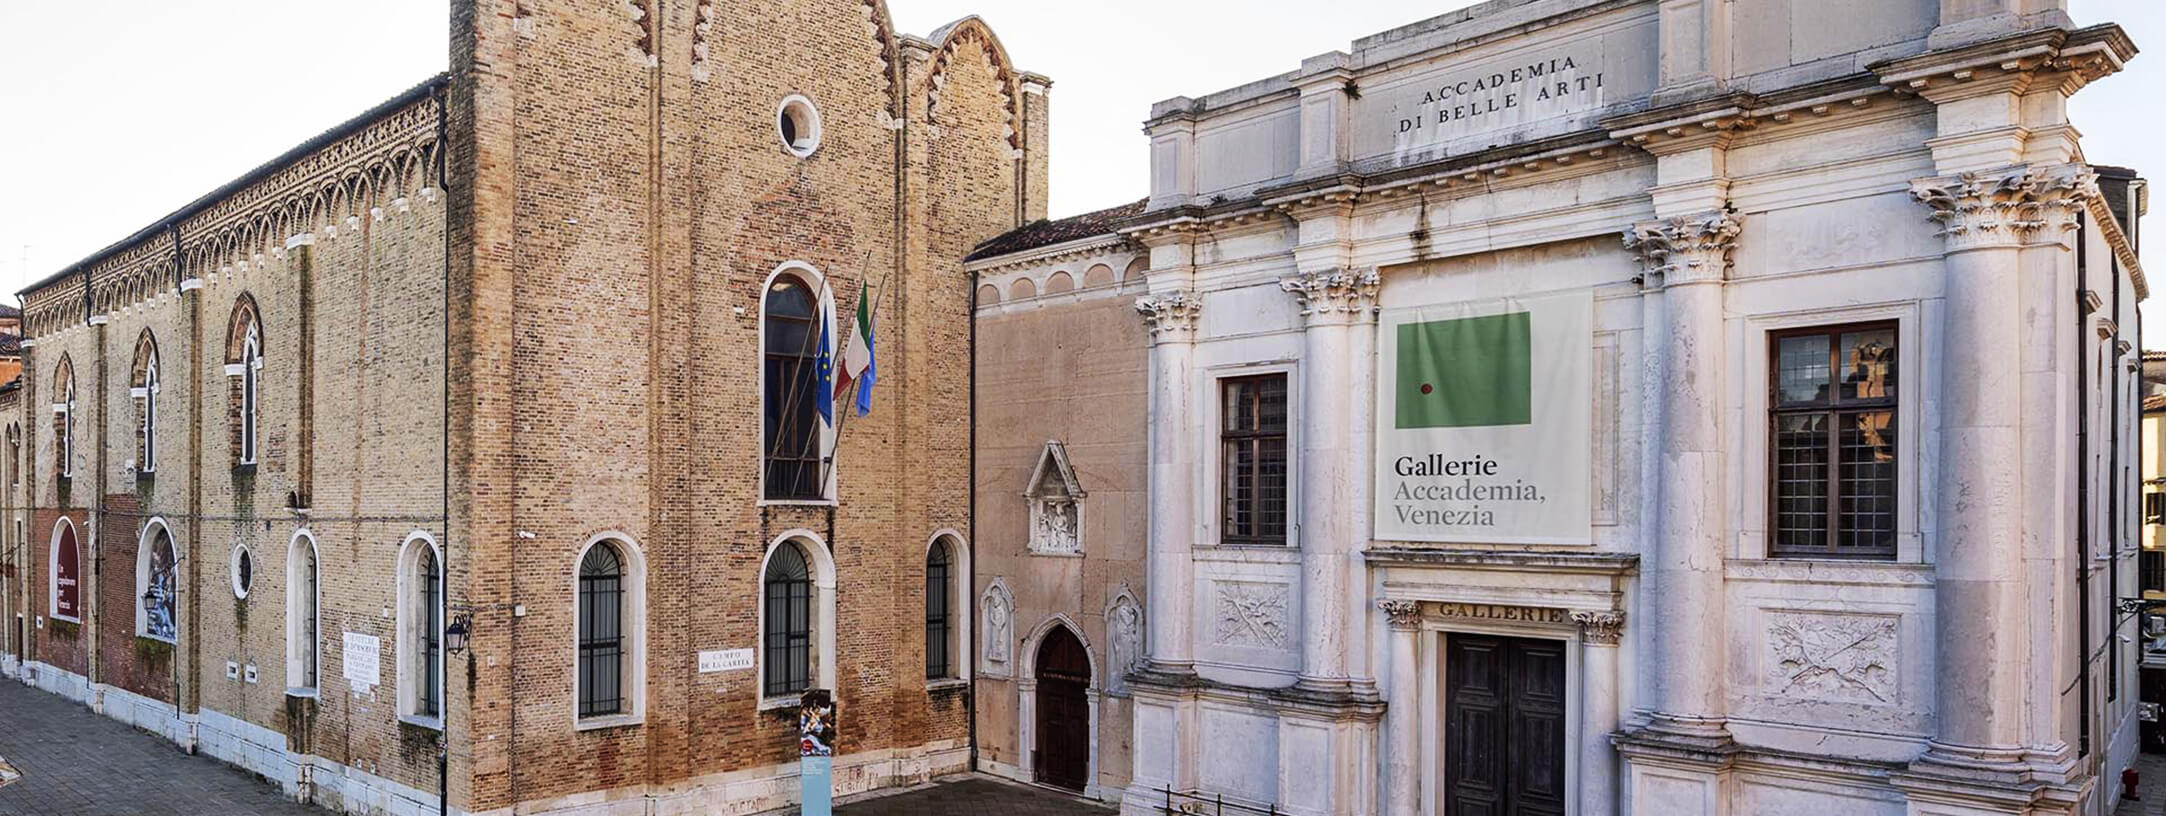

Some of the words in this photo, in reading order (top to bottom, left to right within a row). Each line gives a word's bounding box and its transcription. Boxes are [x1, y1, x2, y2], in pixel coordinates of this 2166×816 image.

[1422, 56, 1576, 105] ACCADEMIA
[1400, 115, 1422, 133] DI
[1439, 93, 1518, 123] BELLE
[1537, 73, 1604, 101] ARTI
[1395, 454, 1498, 476] Gallerie
[1394, 478, 1546, 503] Accademia,
[1395, 505, 1495, 526] Venezia
[1440, 604, 1563, 623] GALLERIE
